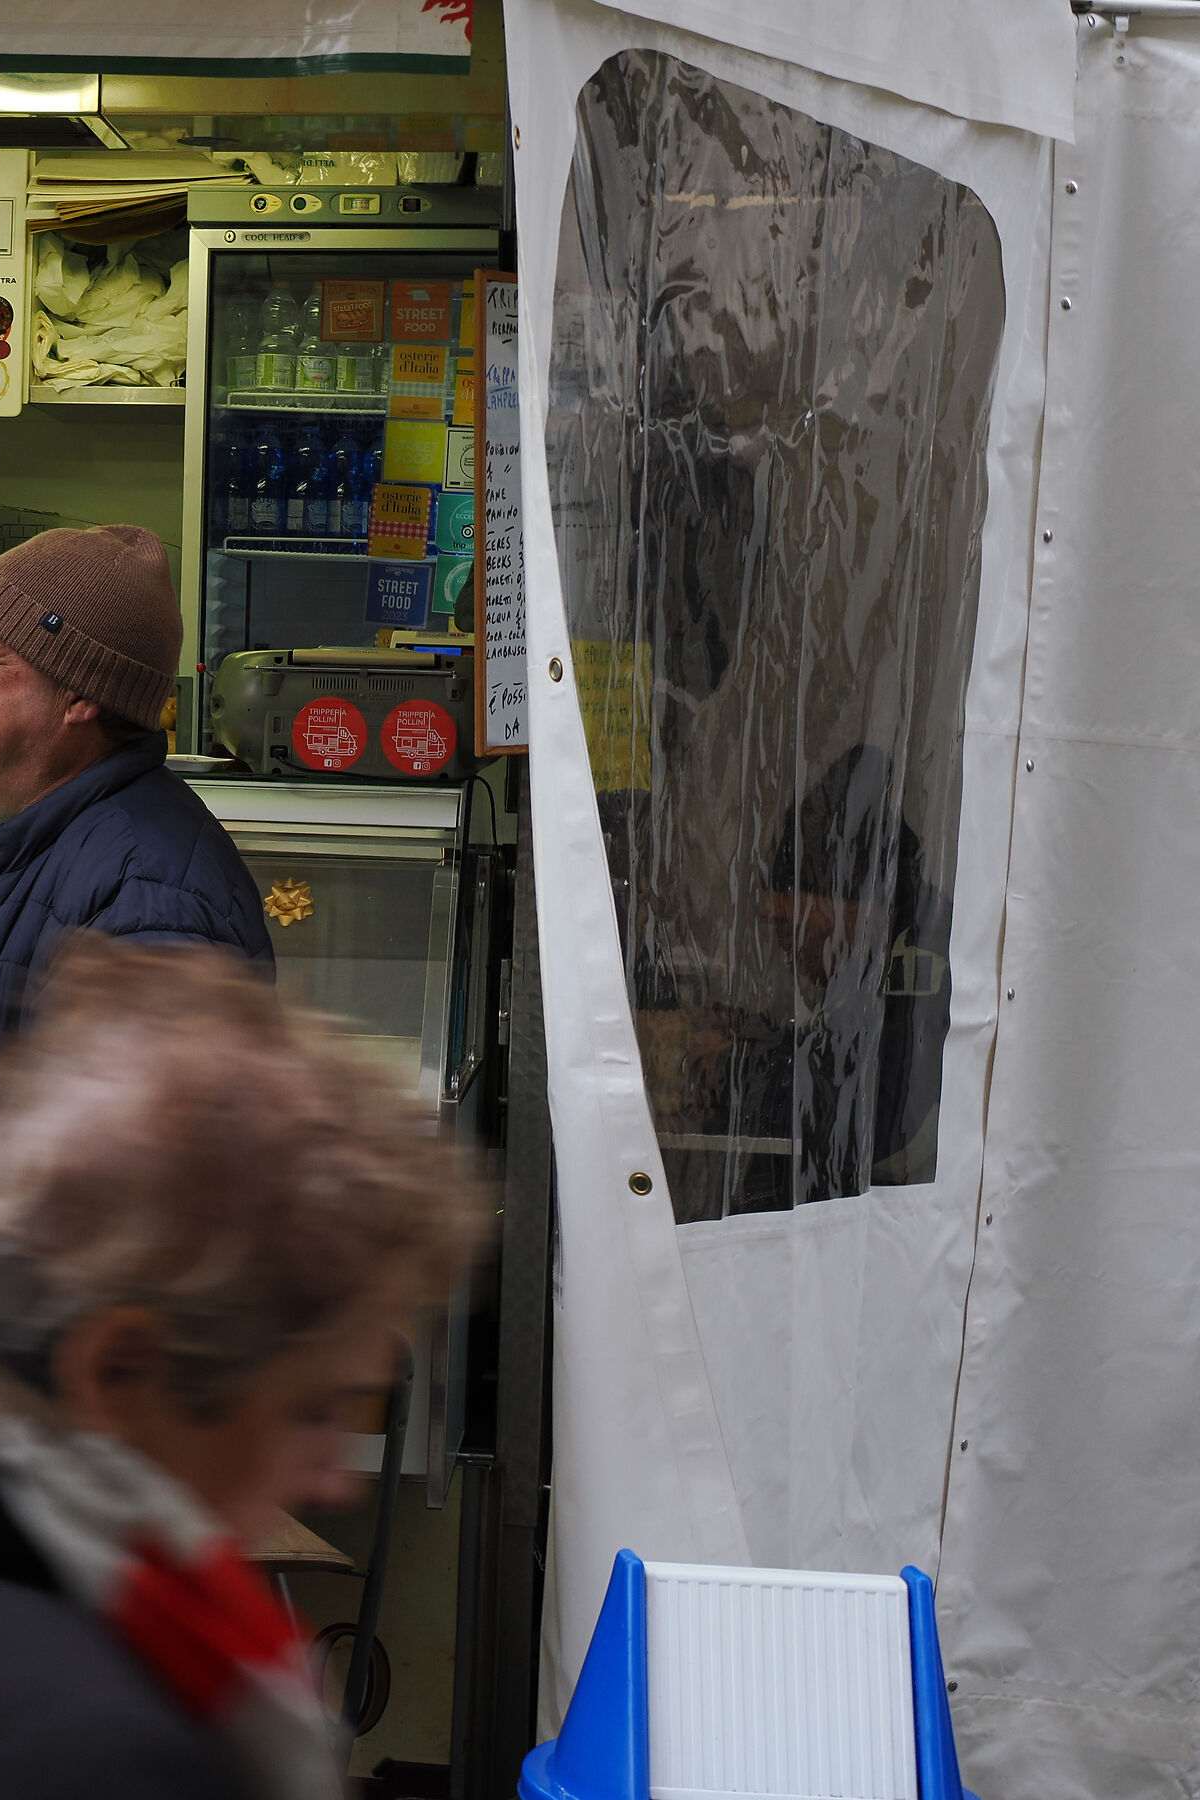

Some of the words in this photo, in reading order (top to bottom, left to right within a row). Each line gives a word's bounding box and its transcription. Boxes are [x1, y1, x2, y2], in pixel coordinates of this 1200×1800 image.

[245, 234, 268, 242] COOL
[396, 307, 445, 320] STREET
[404, 322, 437, 333] FOOD
[400, 350, 439, 361] osterie
[399, 360, 439, 375] d'Italia
[391, 440, 440, 453] STREET
[394, 453, 435, 465] FOOD
[382, 491, 422, 500] osterie
[485, 488, 506, 503] PANE
[381, 501, 421, 515] d'Italia
[485, 536, 511, 552] CERES
[486, 555, 512, 572] BECKS
[377, 578, 419, 596] STREET
[380, 595, 411, 610] FOOD
[382, 610, 408, 621] 2023
[486, 610, 511, 625] ACQUA
[310, 708, 347, 716] TRIPPERIA
[398, 710, 436, 719] TRIPPERIA
[308, 715, 337, 723] POLLINI
[397, 718, 425, 726] POLLINI
[505, 717, 520, 740] DA
